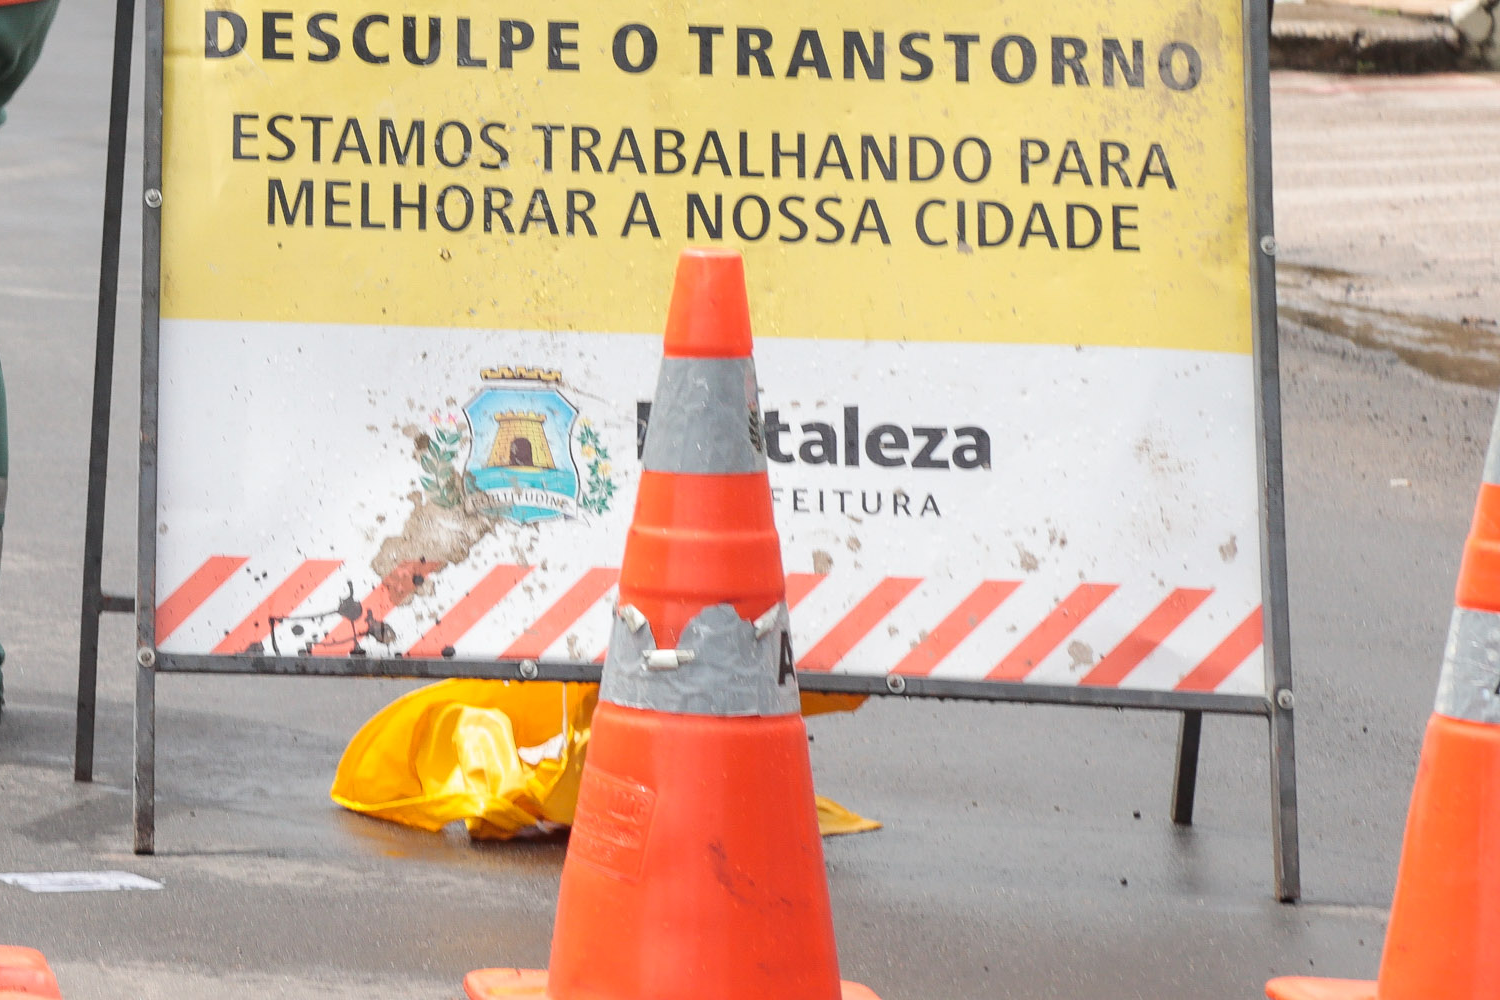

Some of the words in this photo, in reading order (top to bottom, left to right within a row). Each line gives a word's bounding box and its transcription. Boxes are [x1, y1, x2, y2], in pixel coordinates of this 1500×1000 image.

[204, 9, 581, 72] DESCULPE
[611, 22, 659, 74] O
[687, 25, 1203, 92] TRANSTORNO
[232, 113, 509, 171] ESTAMOS
[532, 124, 992, 184] TRABALHANDO
[1019, 138, 1177, 191] PARA
[267, 179, 598, 237] MELHORAR
[621, 191, 662, 239] A
[685, 193, 892, 245] NOSSA
[914, 199, 1141, 252] CIDADE
[636, 401, 992, 470] taleza
[770, 486, 942, 518] FEITURA
